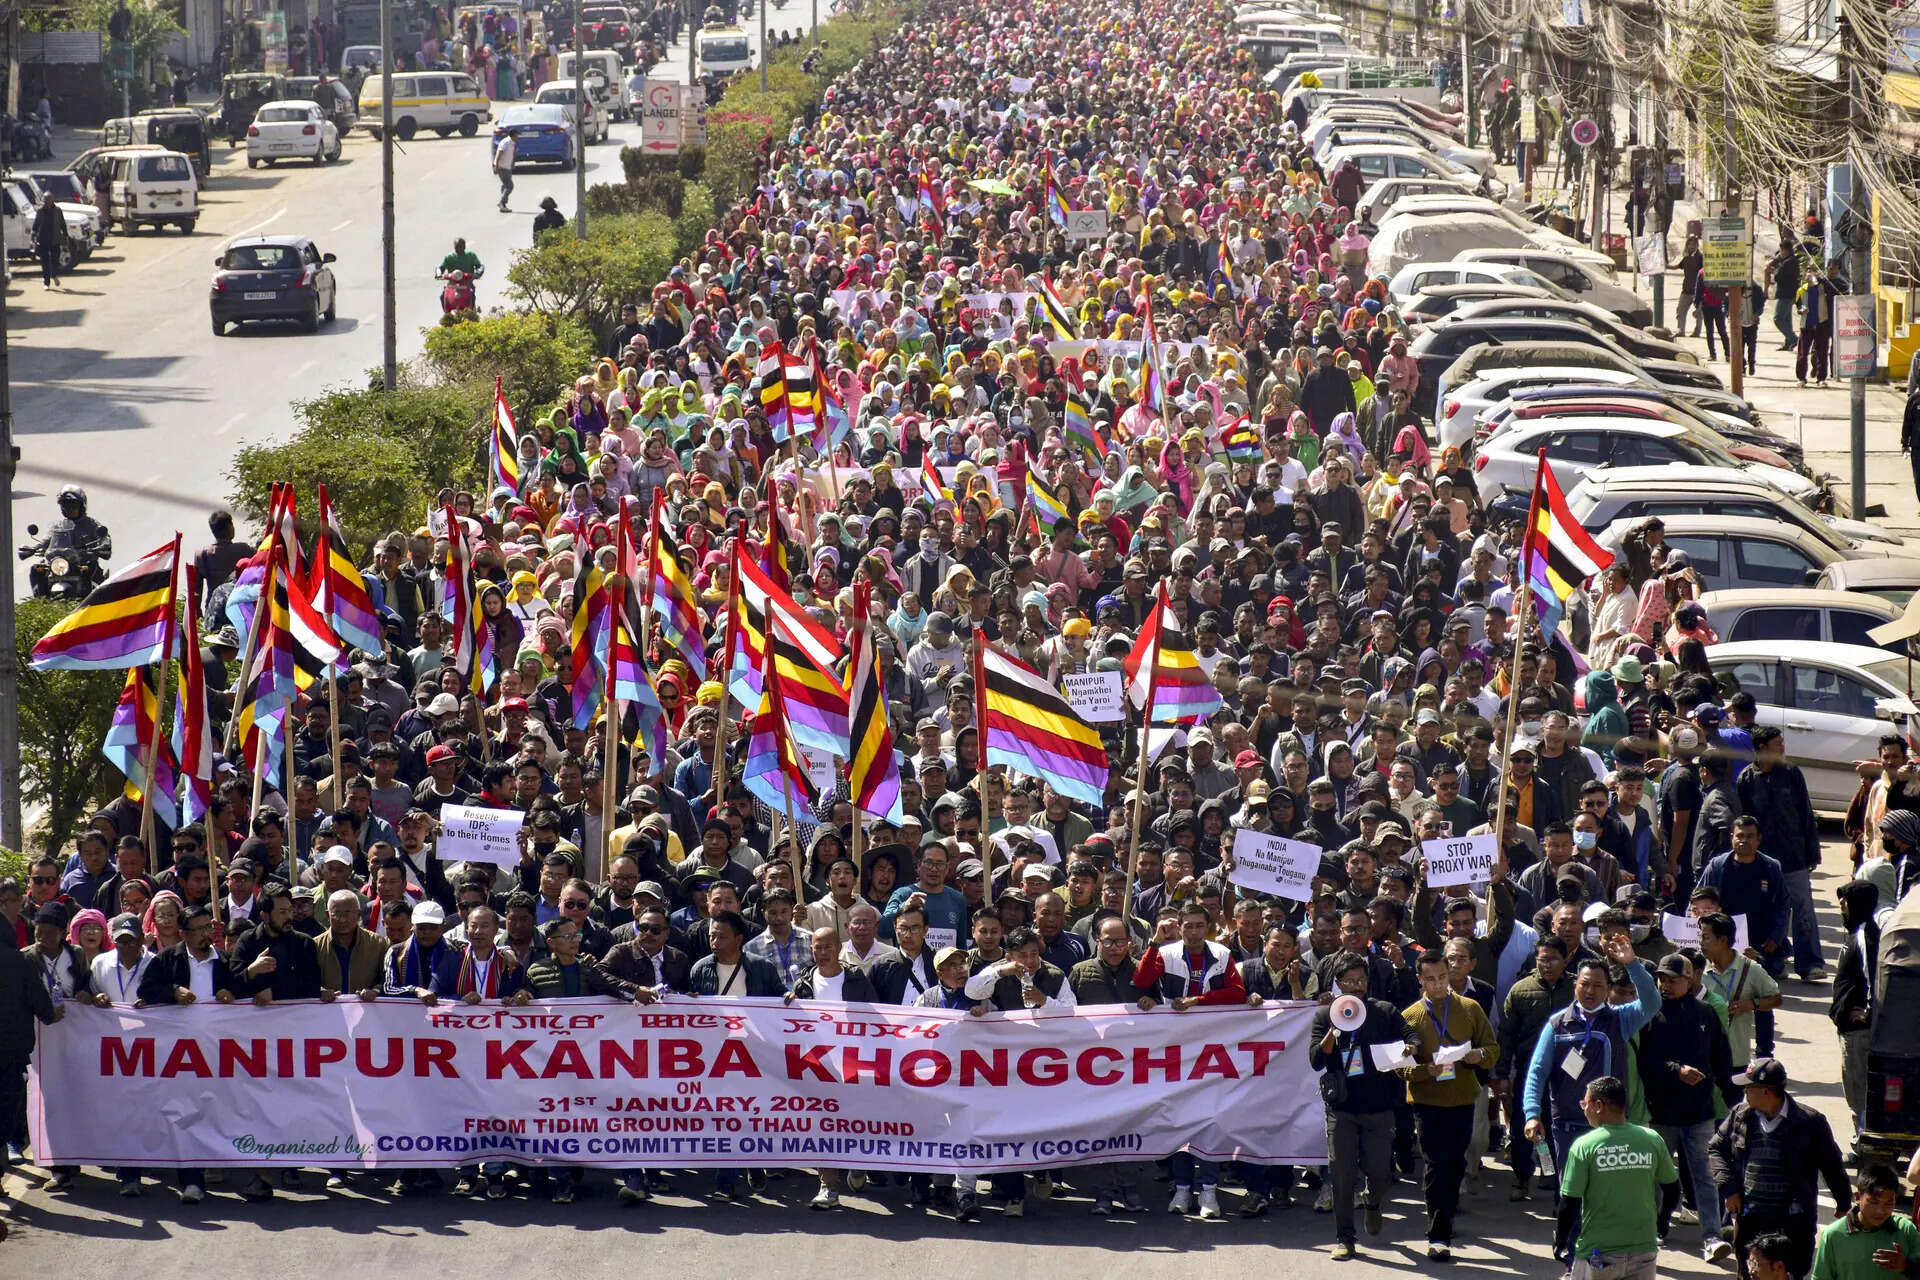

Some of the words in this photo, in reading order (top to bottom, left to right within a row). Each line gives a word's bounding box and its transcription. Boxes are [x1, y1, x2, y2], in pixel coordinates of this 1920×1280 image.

[1065, 676, 1105, 687] MANIPUR
[1071, 685, 1112, 697] Ngamkhei
[1088, 695, 1111, 705] Yaroi
[463, 809, 500, 822] Resettle
[446, 828, 456, 837] to
[457, 829, 478, 840] their
[480, 832, 511, 844] Homes
[1266, 839, 1287, 852] INDIA
[1447, 842, 1473, 858] STOP
[1255, 848, 1265, 859] Na
[1266, 852, 1295, 866] Manipur
[1431, 857, 1465, 875] PROXY
[1467, 854, 1492, 870] WAR
[1279, 865, 1307, 881] Touganu
[101, 1036, 459, 1078] MANIPUR
[784, 1041, 1286, 1088] KHONGCHAT
[677, 1082, 702, 1095] ON
[538, 1096, 597, 1113] 31ST
[606, 1096, 761, 1115] JANUARY,
[769, 1096, 841, 1113] 2026
[464, 1117, 526, 1133] FROM
[533, 1117, 599, 1133] TIDIM
[606, 1117, 704, 1132] GROUND
[712, 1117, 742, 1132] TO
[749, 1117, 812, 1133] THAU
[819, 1118, 915, 1136] GROUND
[232, 1134, 340, 1160] Organised
[344, 1135, 374, 1161] by:
[377, 1134, 580, 1155] COORDINATING
[587, 1137, 732, 1154] COMMITTEE
[739, 1137, 774, 1154] ON
[781, 1137, 892, 1156] MANIPUR
[898, 1140, 1025, 1160] INTEGRITY
[1032, 1135, 1145, 1161] (COCOMI)
[1596, 1152, 1653, 1168] COCOMI
